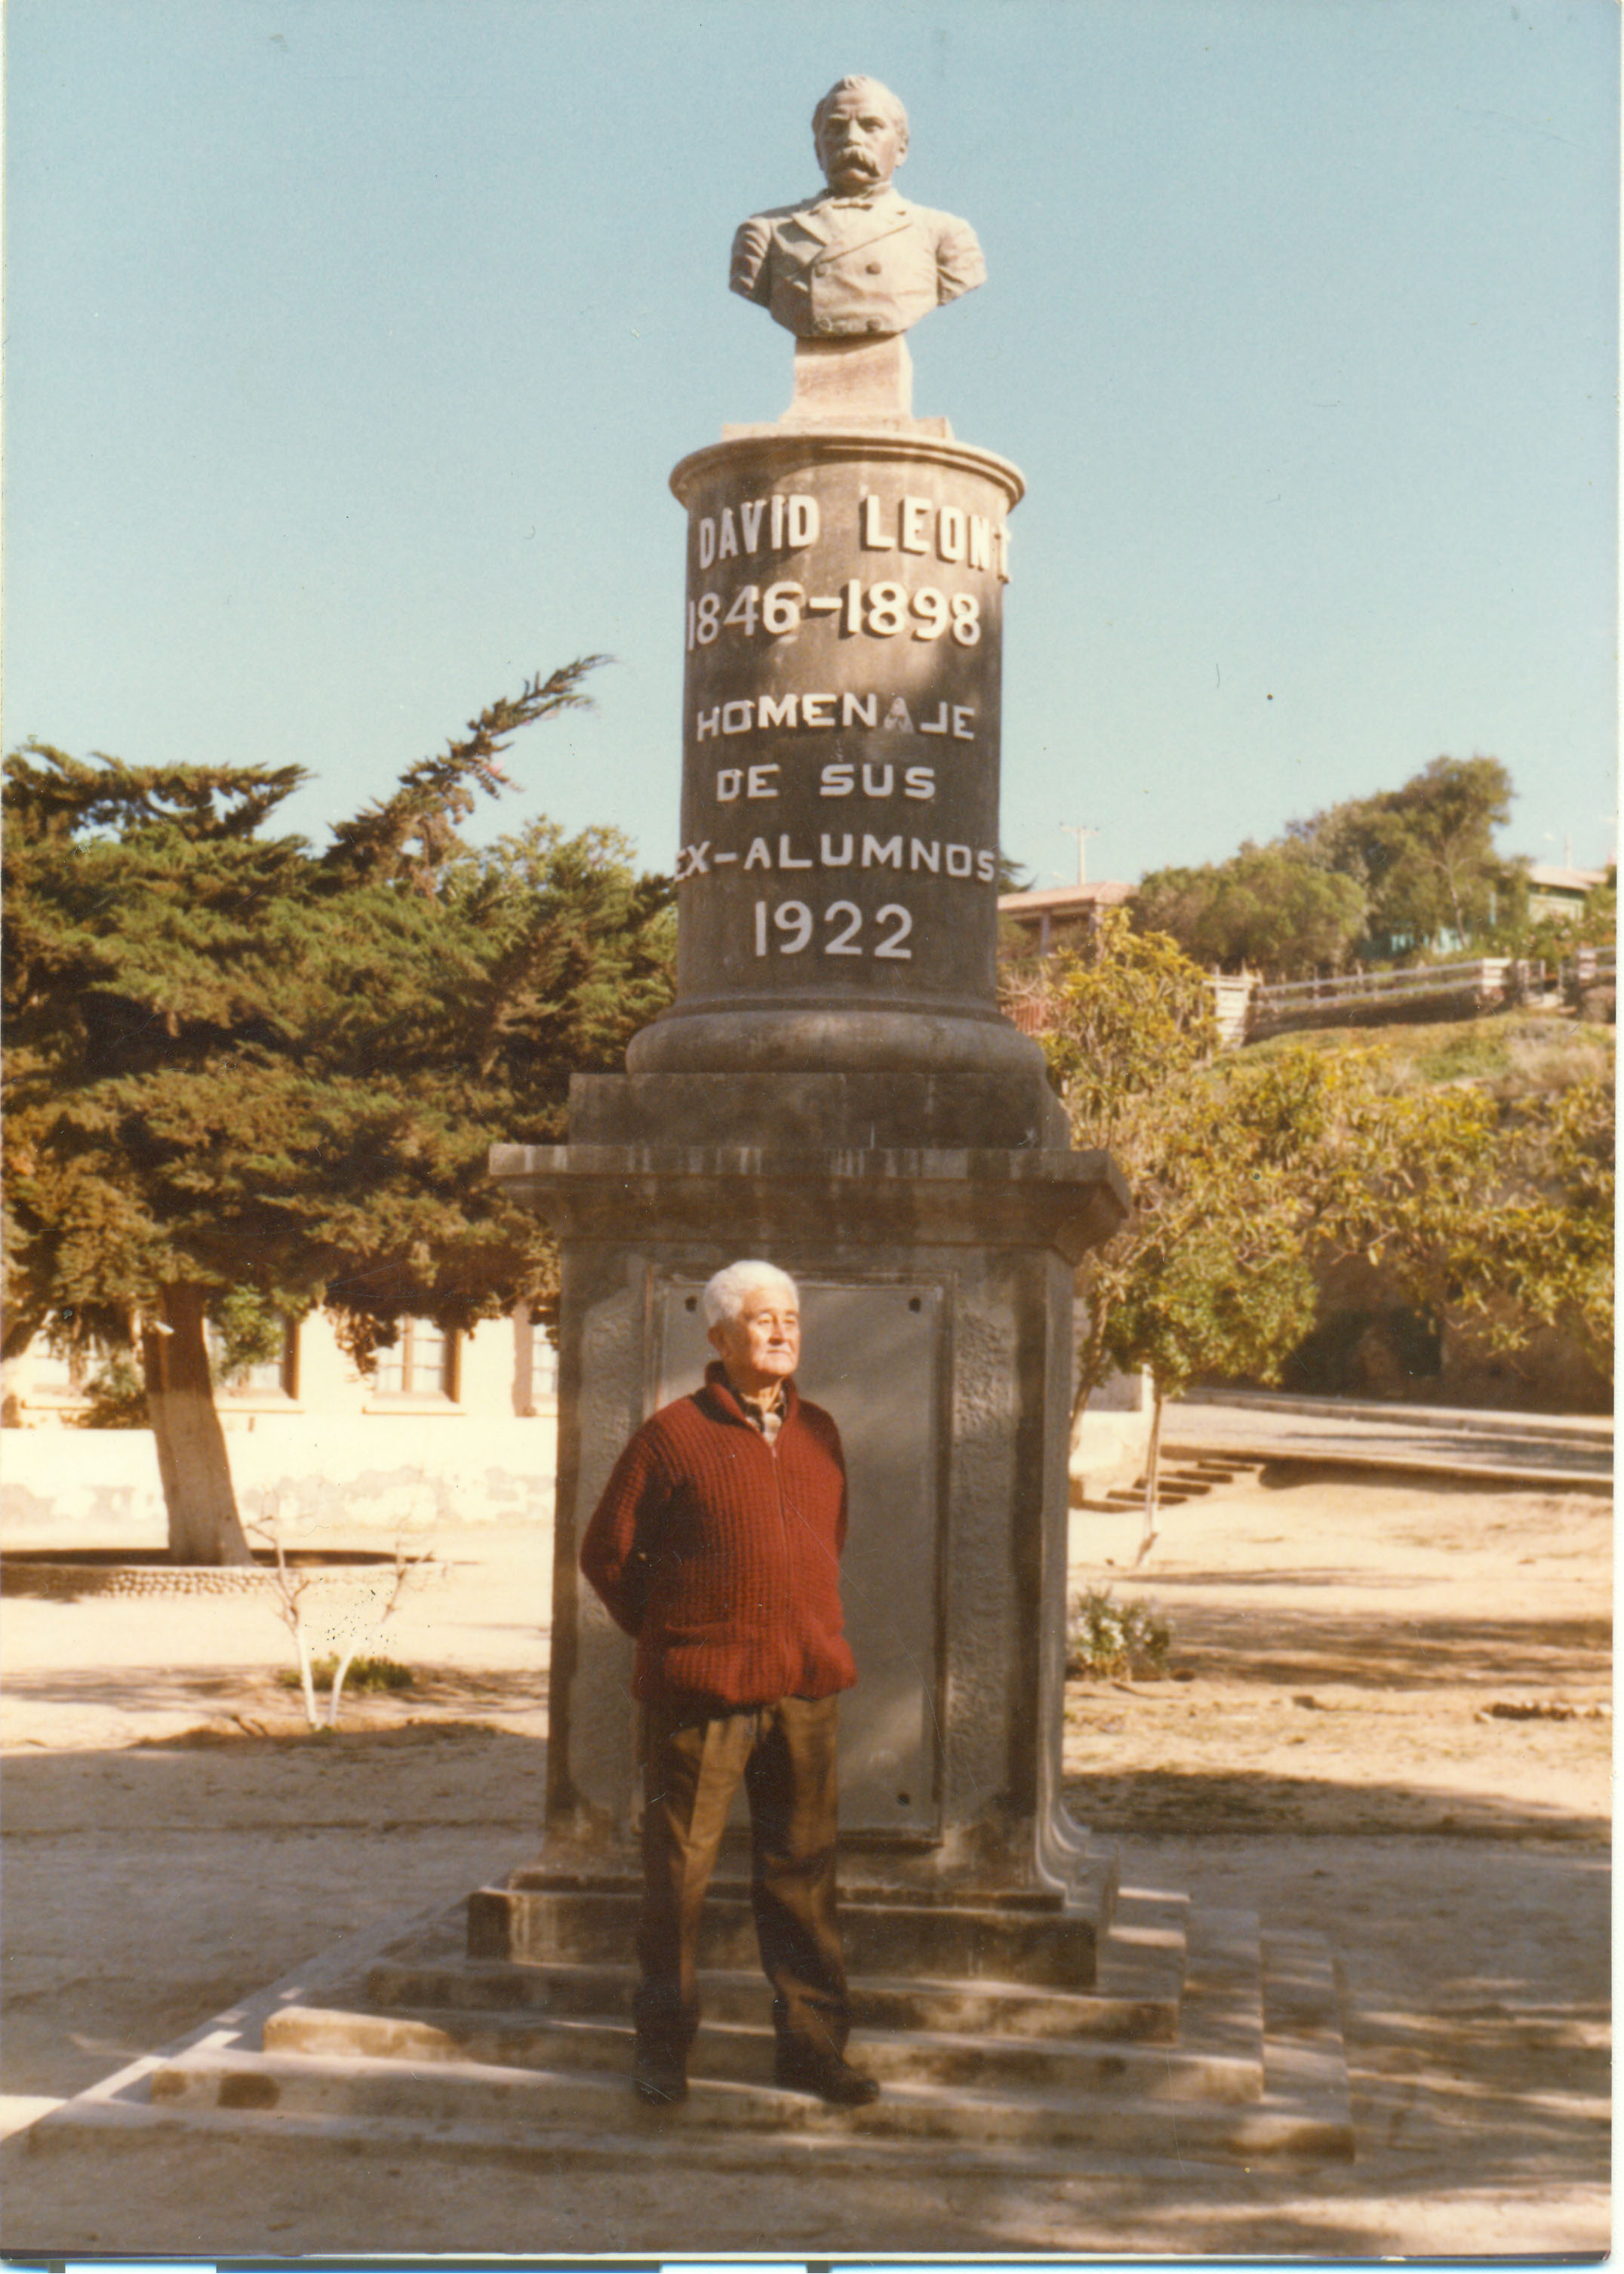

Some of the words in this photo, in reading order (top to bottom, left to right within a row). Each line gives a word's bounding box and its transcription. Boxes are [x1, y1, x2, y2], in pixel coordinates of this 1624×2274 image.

[699, 494, 820, 570] DAVID
[688, 579, 982, 651] 1846-1898
[696, 692, 975, 742] HOMENAJE
[716, 763, 780, 802] DE
[820, 763, 937, 800] SUS
[674, 833, 995, 882] EX-ALUMNOS
[755, 900, 912, 959] 1922
